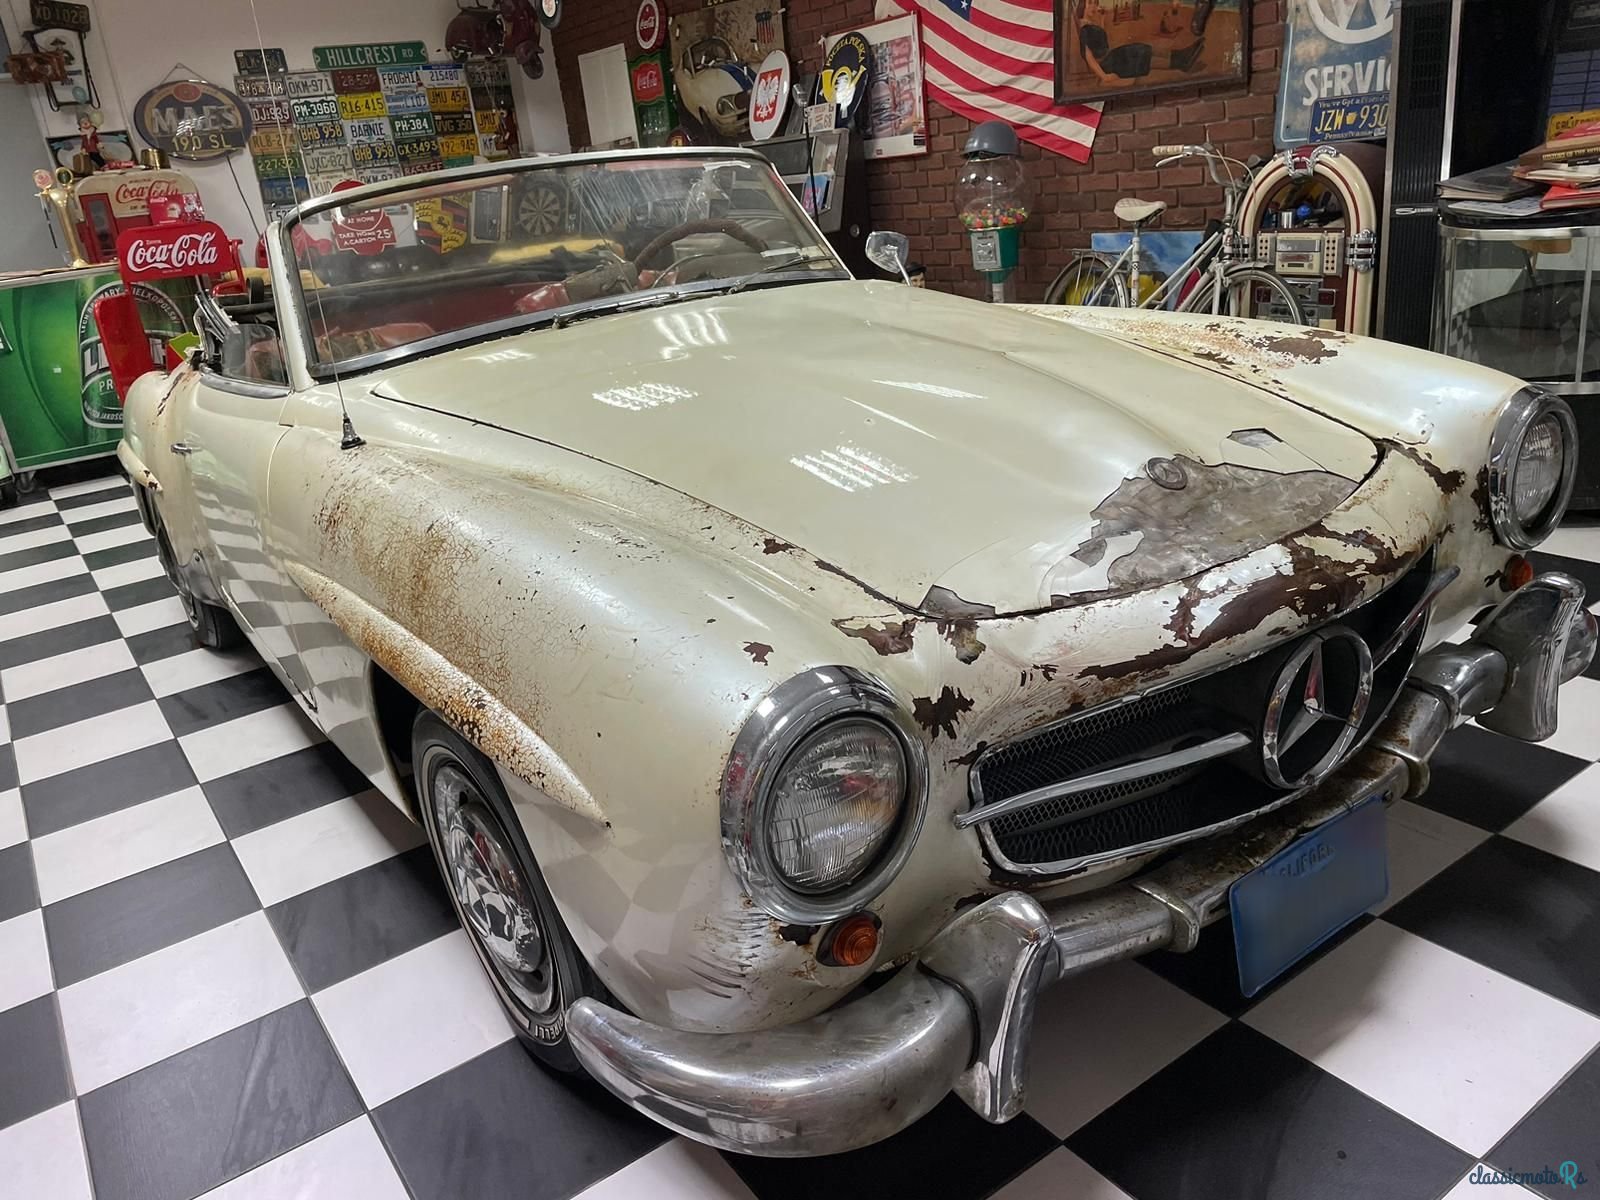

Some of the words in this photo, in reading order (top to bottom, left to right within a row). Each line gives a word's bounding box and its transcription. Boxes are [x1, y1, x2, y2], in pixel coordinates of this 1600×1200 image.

[326, 46, 397, 66] HILLCREST
[1315, 109, 1345, 133] JZW
[1359, 103, 1390, 129] 930
[350, 122, 385, 138] BARNIE
[173, 135, 202, 152] 190
[209, 134, 232, 149] SL
[127, 231, 218, 272] Coca-Cola
